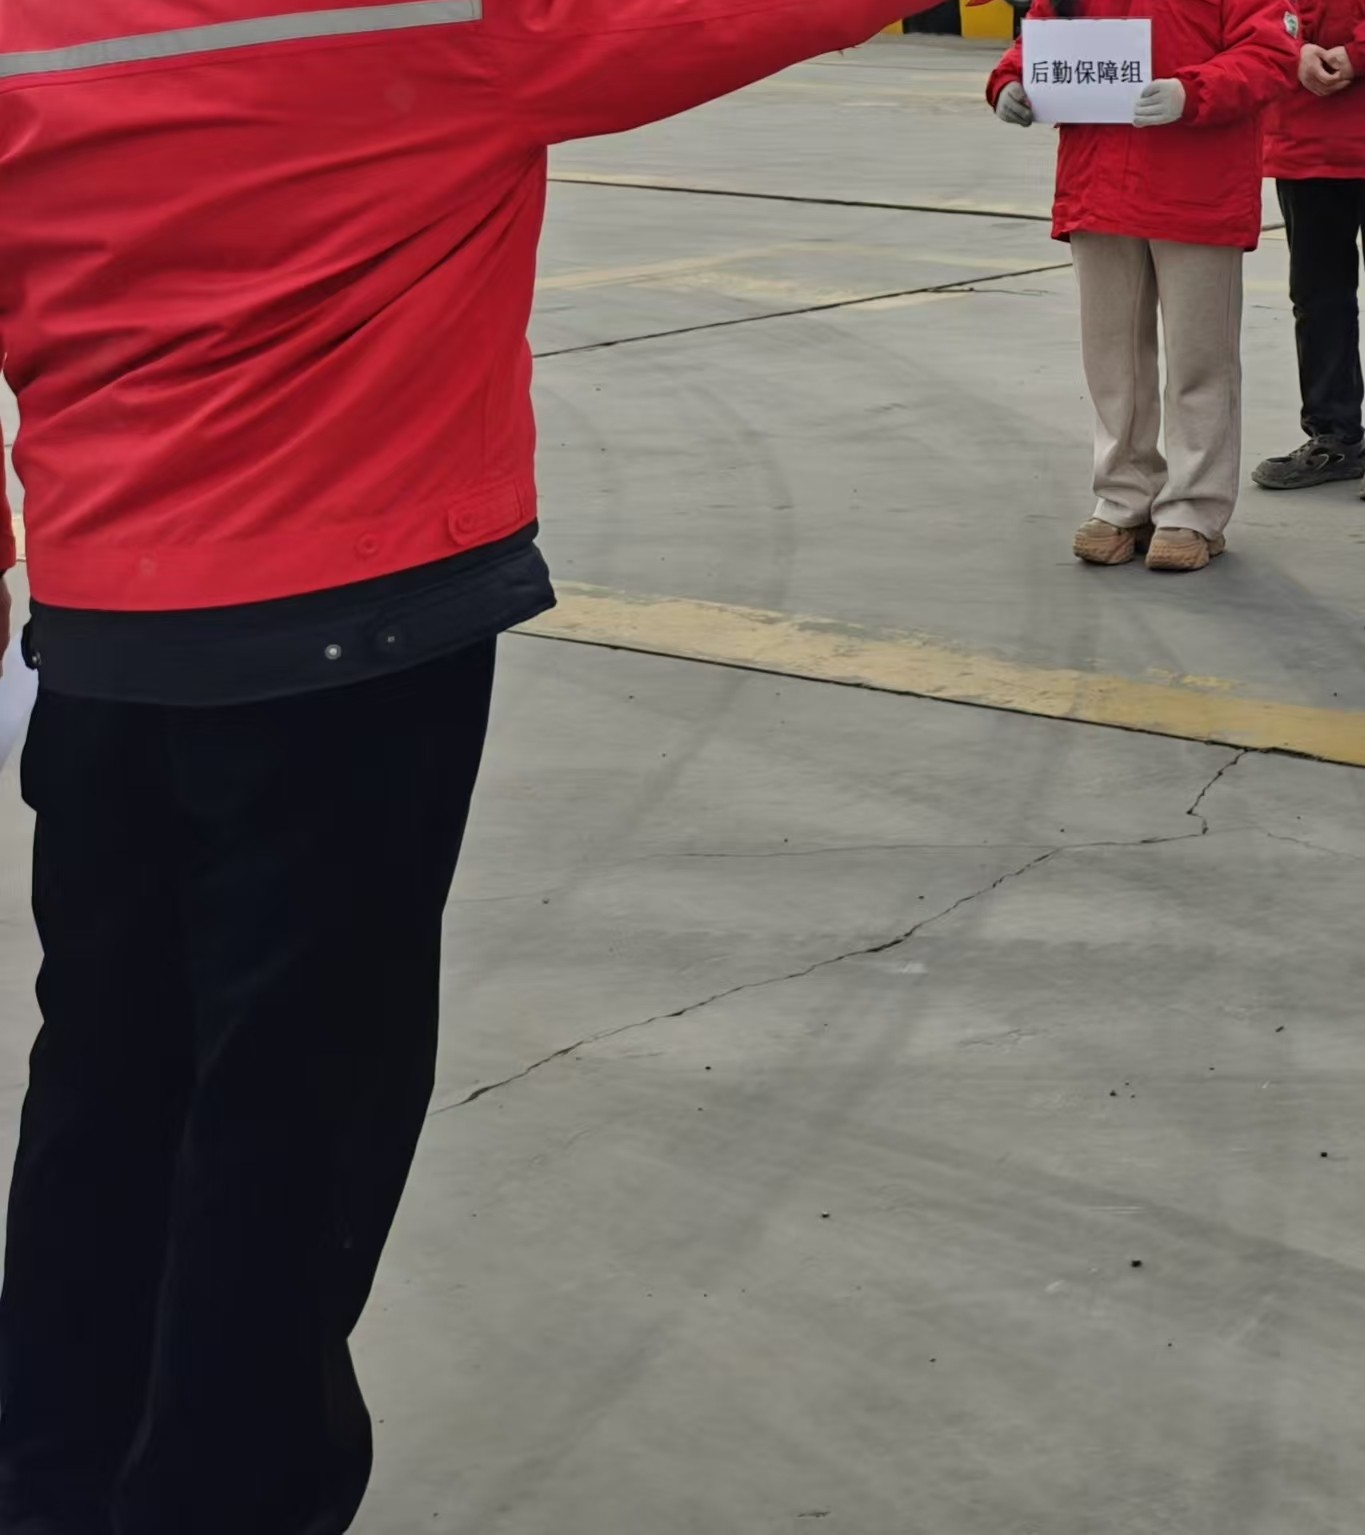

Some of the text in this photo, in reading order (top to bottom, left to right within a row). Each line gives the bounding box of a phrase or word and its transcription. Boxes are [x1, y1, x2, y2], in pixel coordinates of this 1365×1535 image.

[1029, 60, 1144, 85] 后勤保障组
